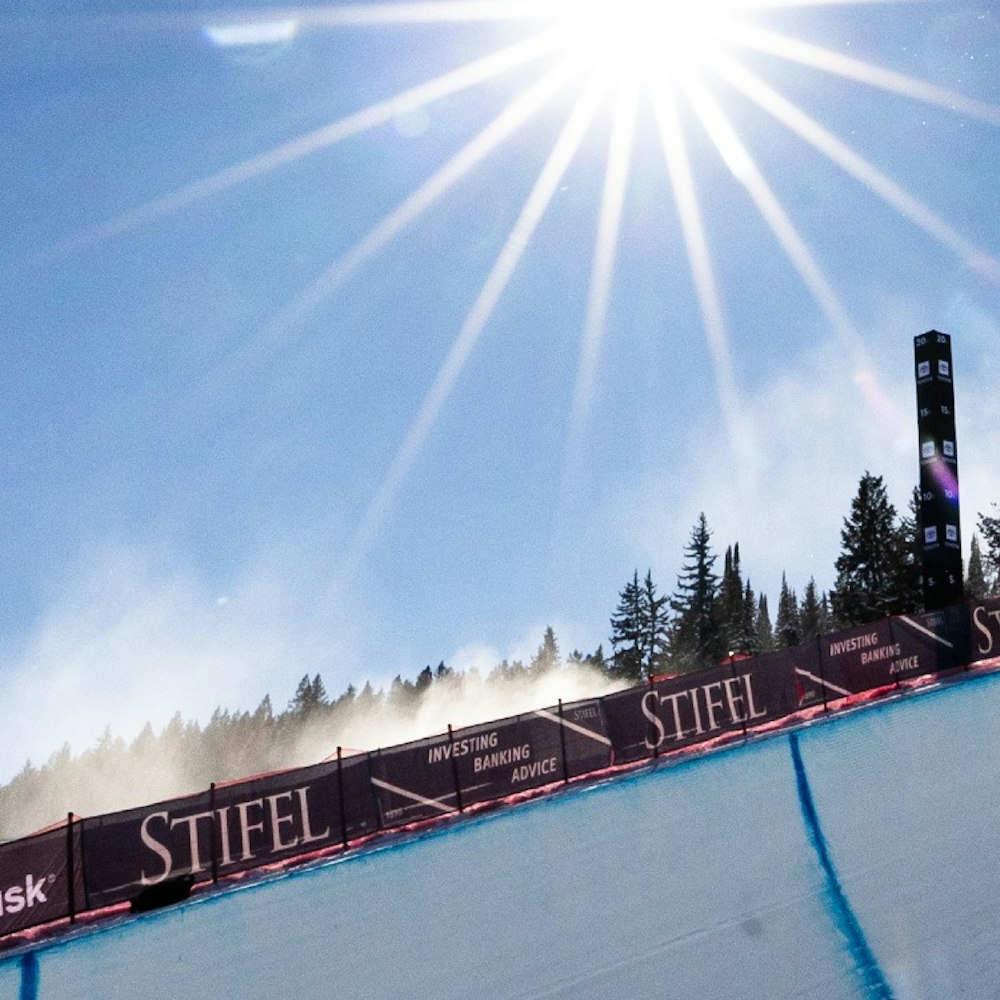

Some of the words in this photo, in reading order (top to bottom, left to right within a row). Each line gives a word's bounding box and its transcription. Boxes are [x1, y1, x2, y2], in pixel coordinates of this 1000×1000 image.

[829, 632, 878, 657] INVESTING
[860, 643, 901, 665] BANKING
[889, 655, 919, 674] ADVICE
[640, 673, 768, 750] STIFEL
[428, 732, 499, 764] INVESTING
[473, 744, 531, 773] BANKING
[511, 757, 558, 784] ADVICE
[139, 785, 330, 886] STIFEL
